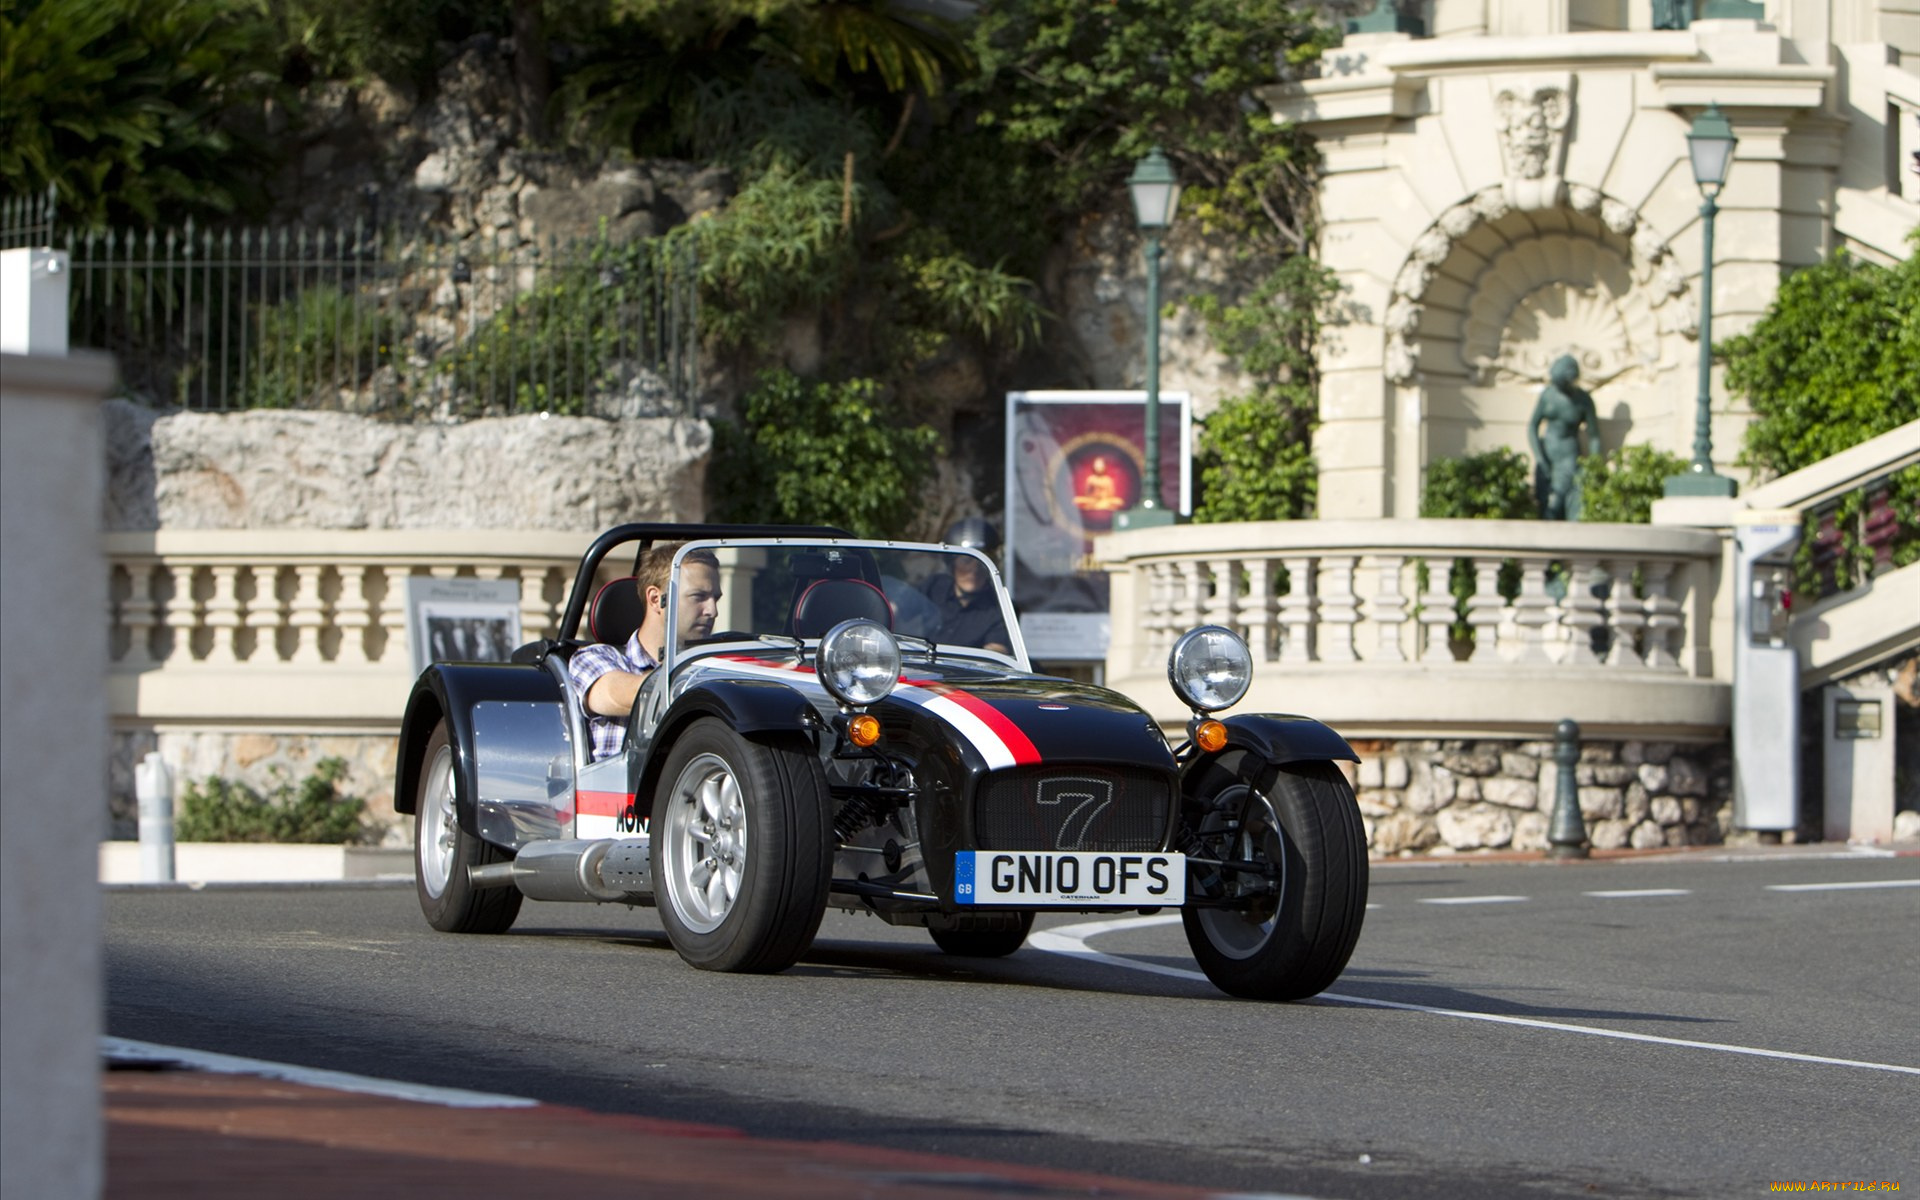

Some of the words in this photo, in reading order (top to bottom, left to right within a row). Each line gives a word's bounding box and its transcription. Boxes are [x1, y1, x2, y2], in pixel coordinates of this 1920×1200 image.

[1037, 776, 1112, 850] 7
[958, 884, 972, 895] GB
[991, 855, 1079, 894] GN10
[1093, 856, 1169, 895] OFS
